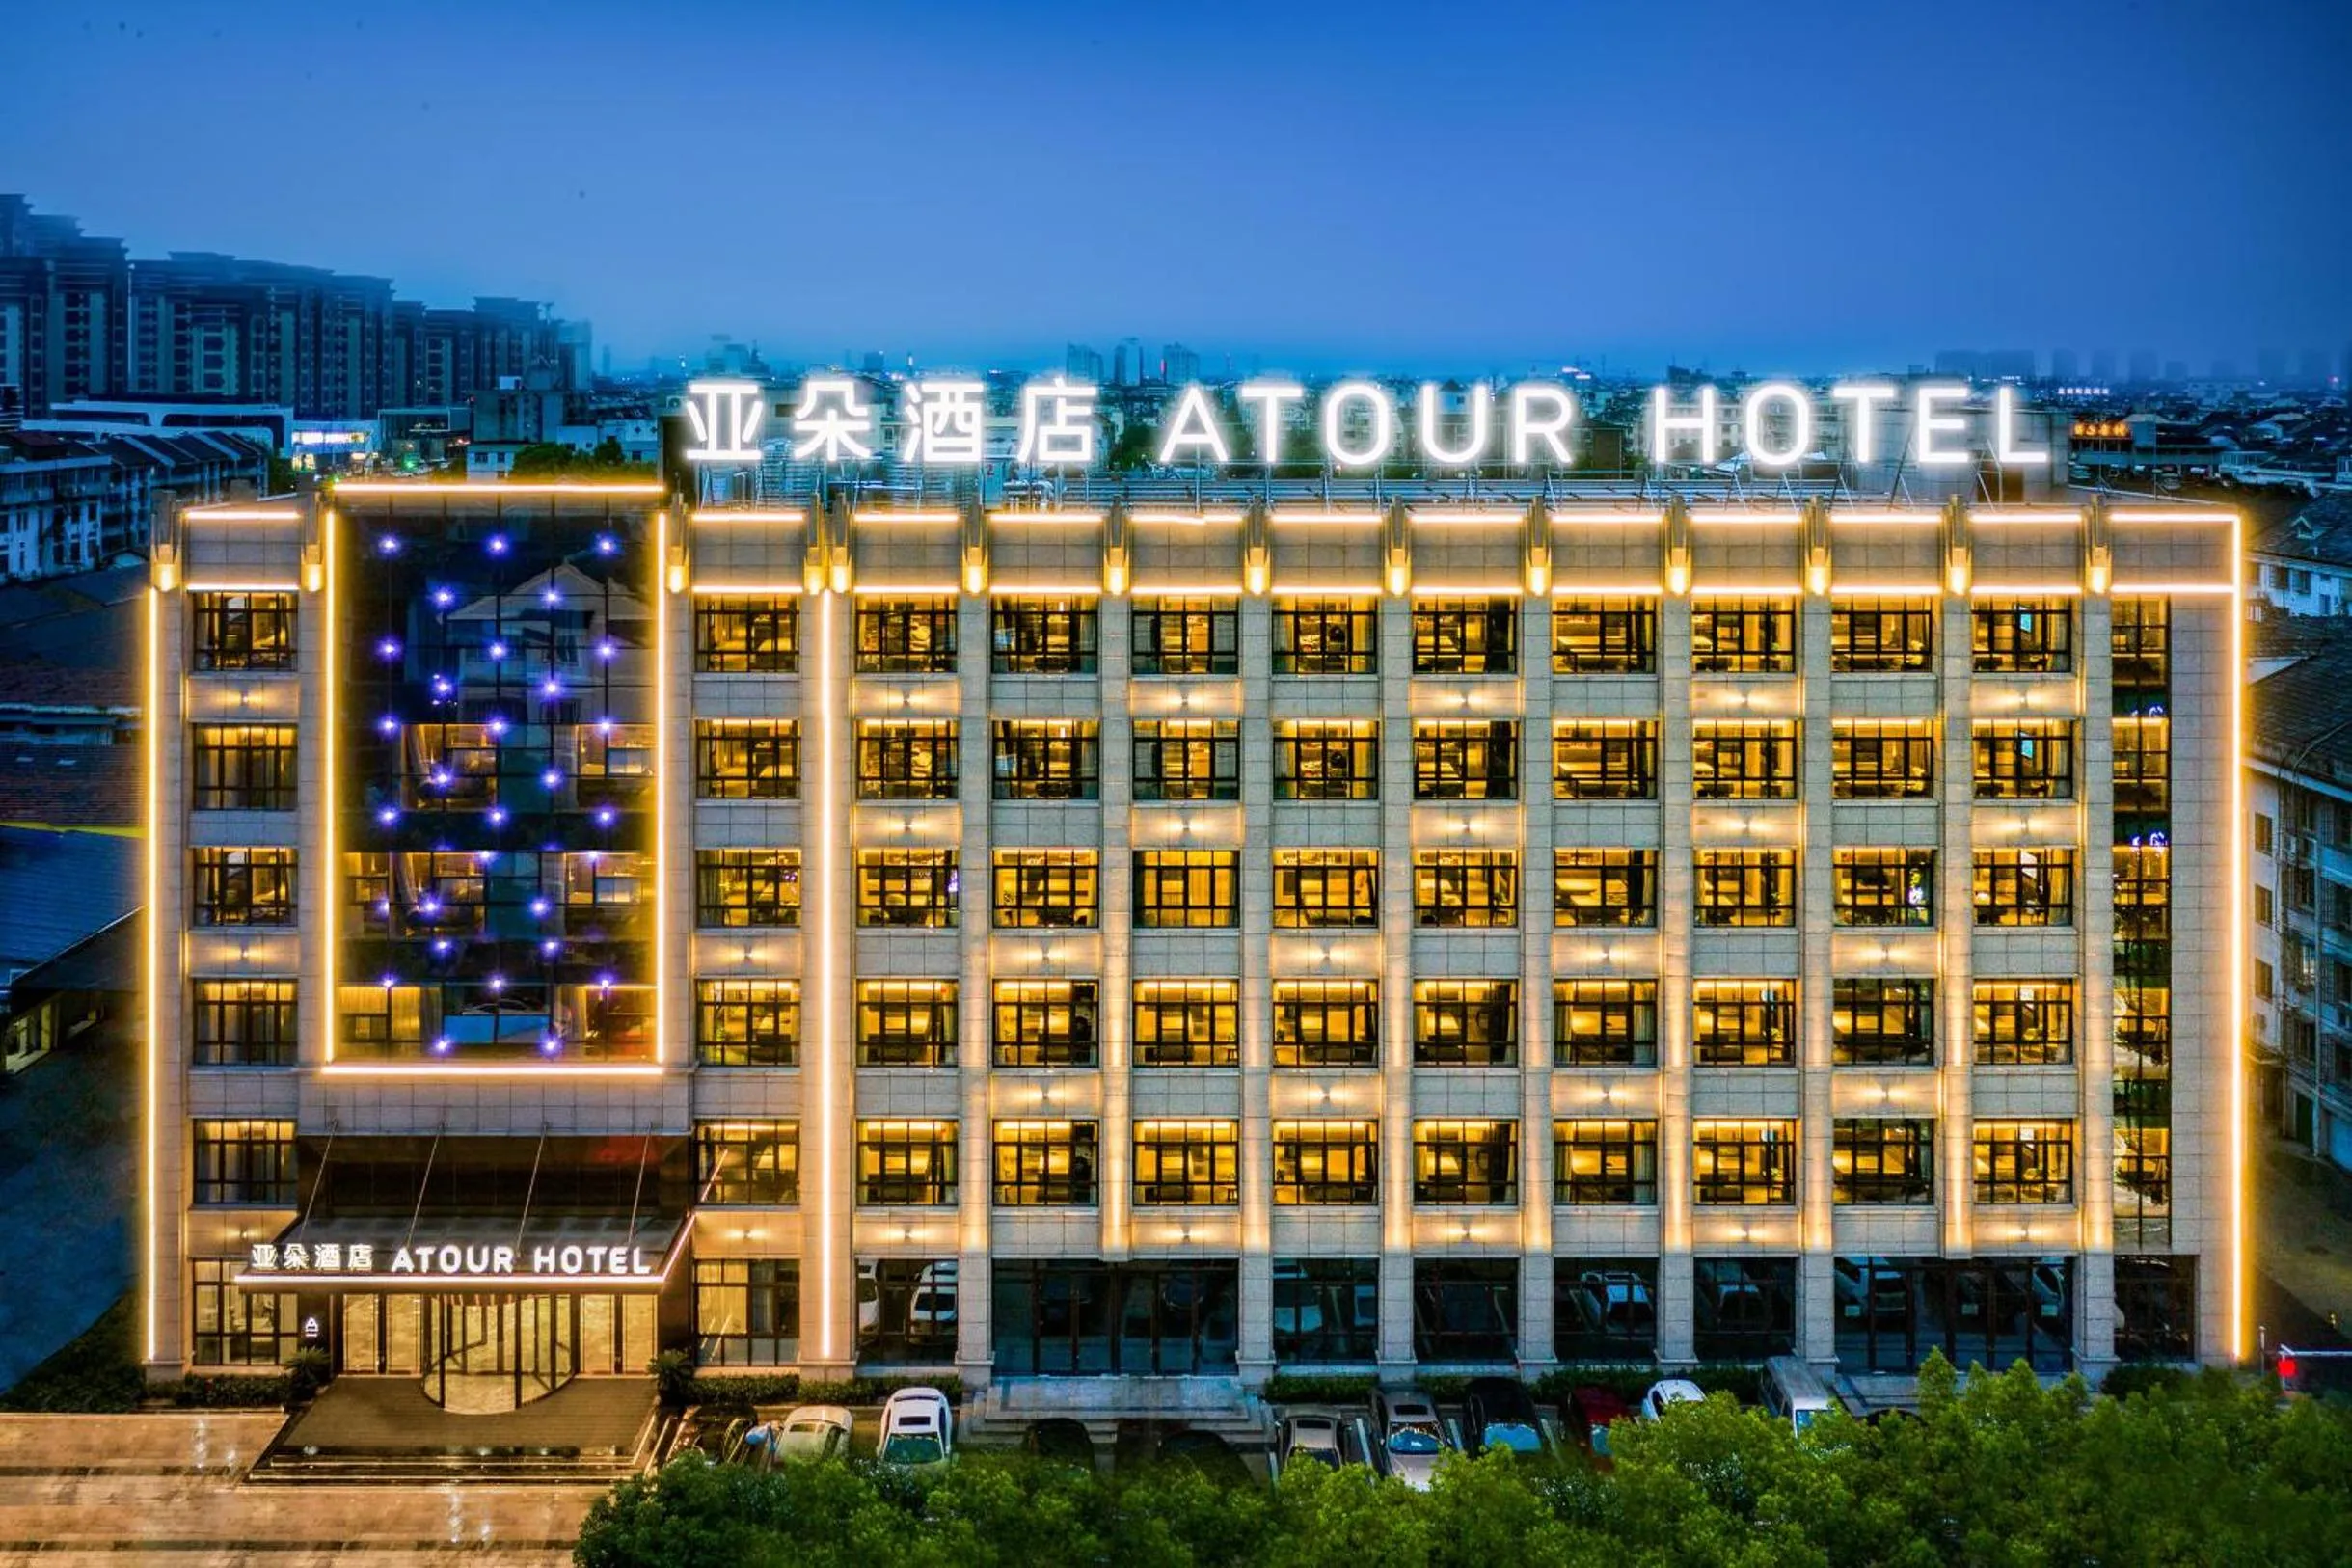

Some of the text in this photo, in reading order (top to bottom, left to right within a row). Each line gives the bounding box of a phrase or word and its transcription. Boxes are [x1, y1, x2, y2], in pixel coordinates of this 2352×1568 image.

[686, 379, 2048, 467] 亚朵酒店 ATOUR HOTEL
[251, 1242, 652, 1275] 亚朵酒店 ATOUR HOTEL
